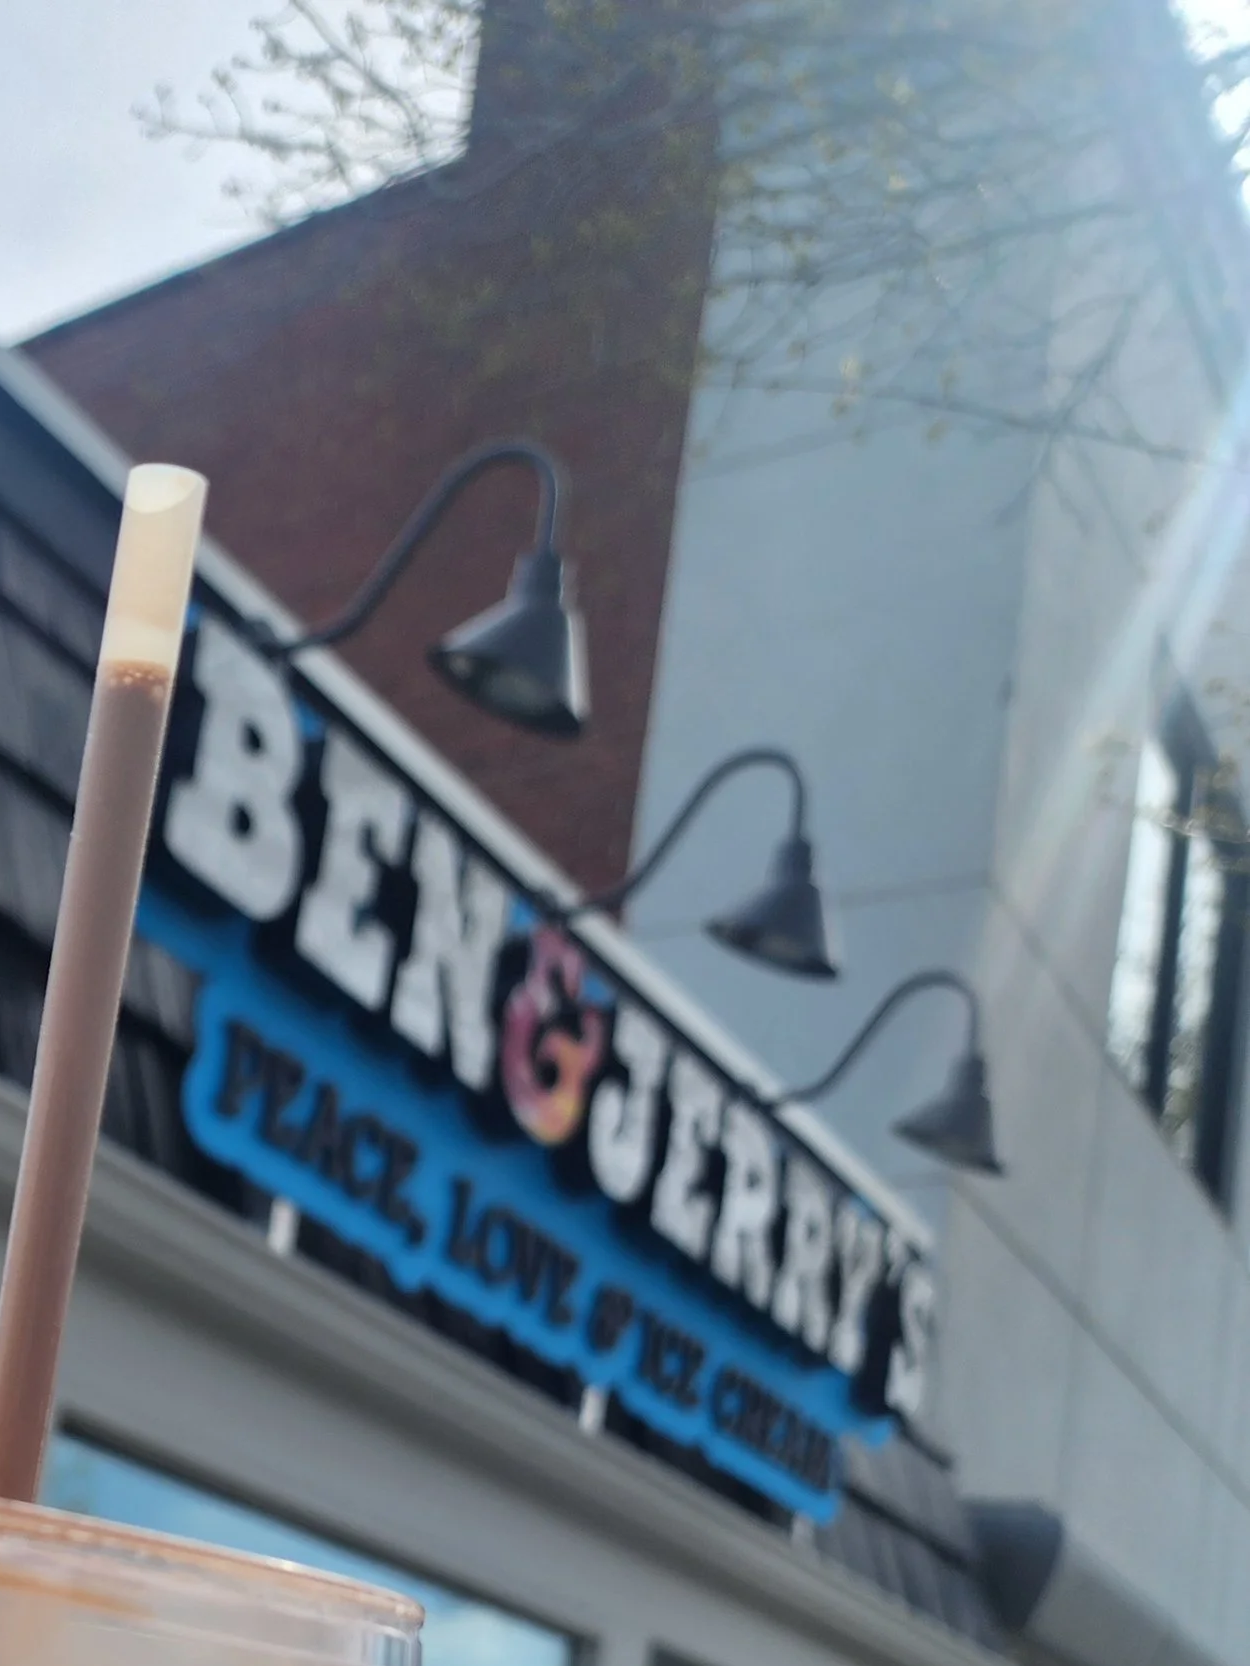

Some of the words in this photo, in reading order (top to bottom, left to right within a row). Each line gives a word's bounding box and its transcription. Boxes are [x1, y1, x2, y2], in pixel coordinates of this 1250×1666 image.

[164, 612, 512, 1091] BEN
[502, 925, 604, 1145] &
[590, 999, 938, 1413] JERRY'S
[216, 1018, 426, 1247] PEACE,
[446, 1175, 580, 1327] LOVE
[639, 1310, 704, 1410] ICE
[711, 1363, 836, 1492] CREAM
